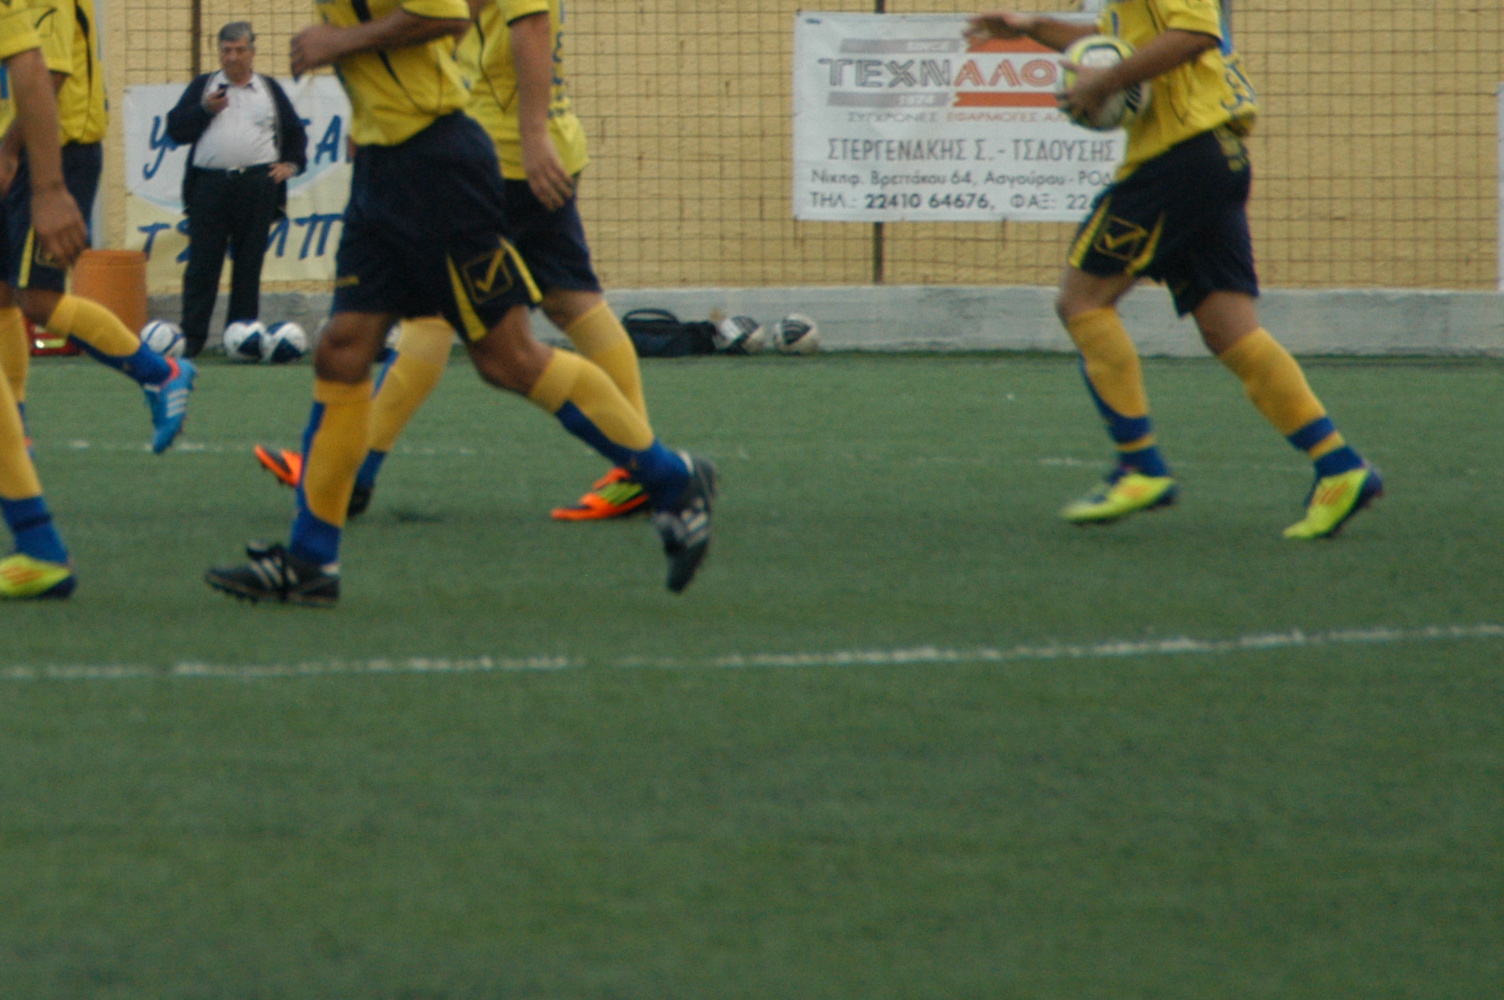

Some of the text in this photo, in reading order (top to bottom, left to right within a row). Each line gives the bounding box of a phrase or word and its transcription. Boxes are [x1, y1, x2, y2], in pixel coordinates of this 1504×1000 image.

[817, 57, 1058, 88] ΤΕΧΝΑΛΟ
[827, 138, 967, 161] ΣΤΕΡΓΕΝΑΚΗΣ
[864, 193, 922, 210] 22410
[1066, 193, 1095, 210] 22
